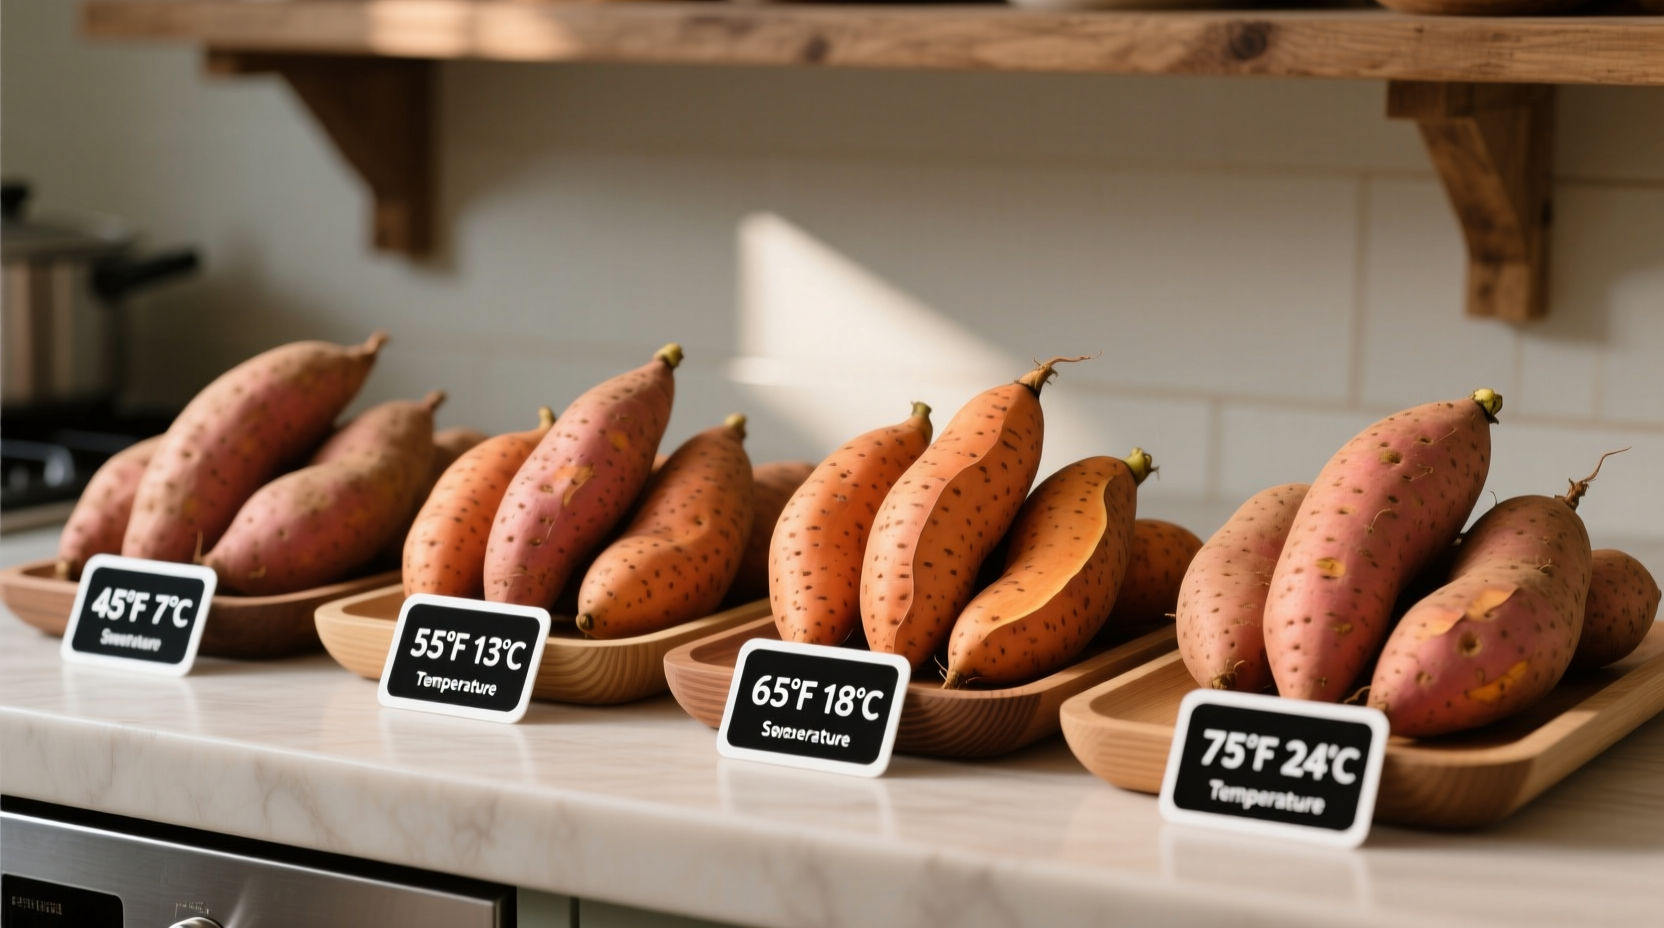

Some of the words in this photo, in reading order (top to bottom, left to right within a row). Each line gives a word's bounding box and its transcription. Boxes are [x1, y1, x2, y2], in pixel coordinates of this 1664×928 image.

[410, 627, 470, 661] 55°F
[474, 635, 526, 670] 13°C
[752, 674, 818, 710] 65°F
[823, 683, 884, 721] 18°C
[1201, 728, 1280, 772] 75°F
